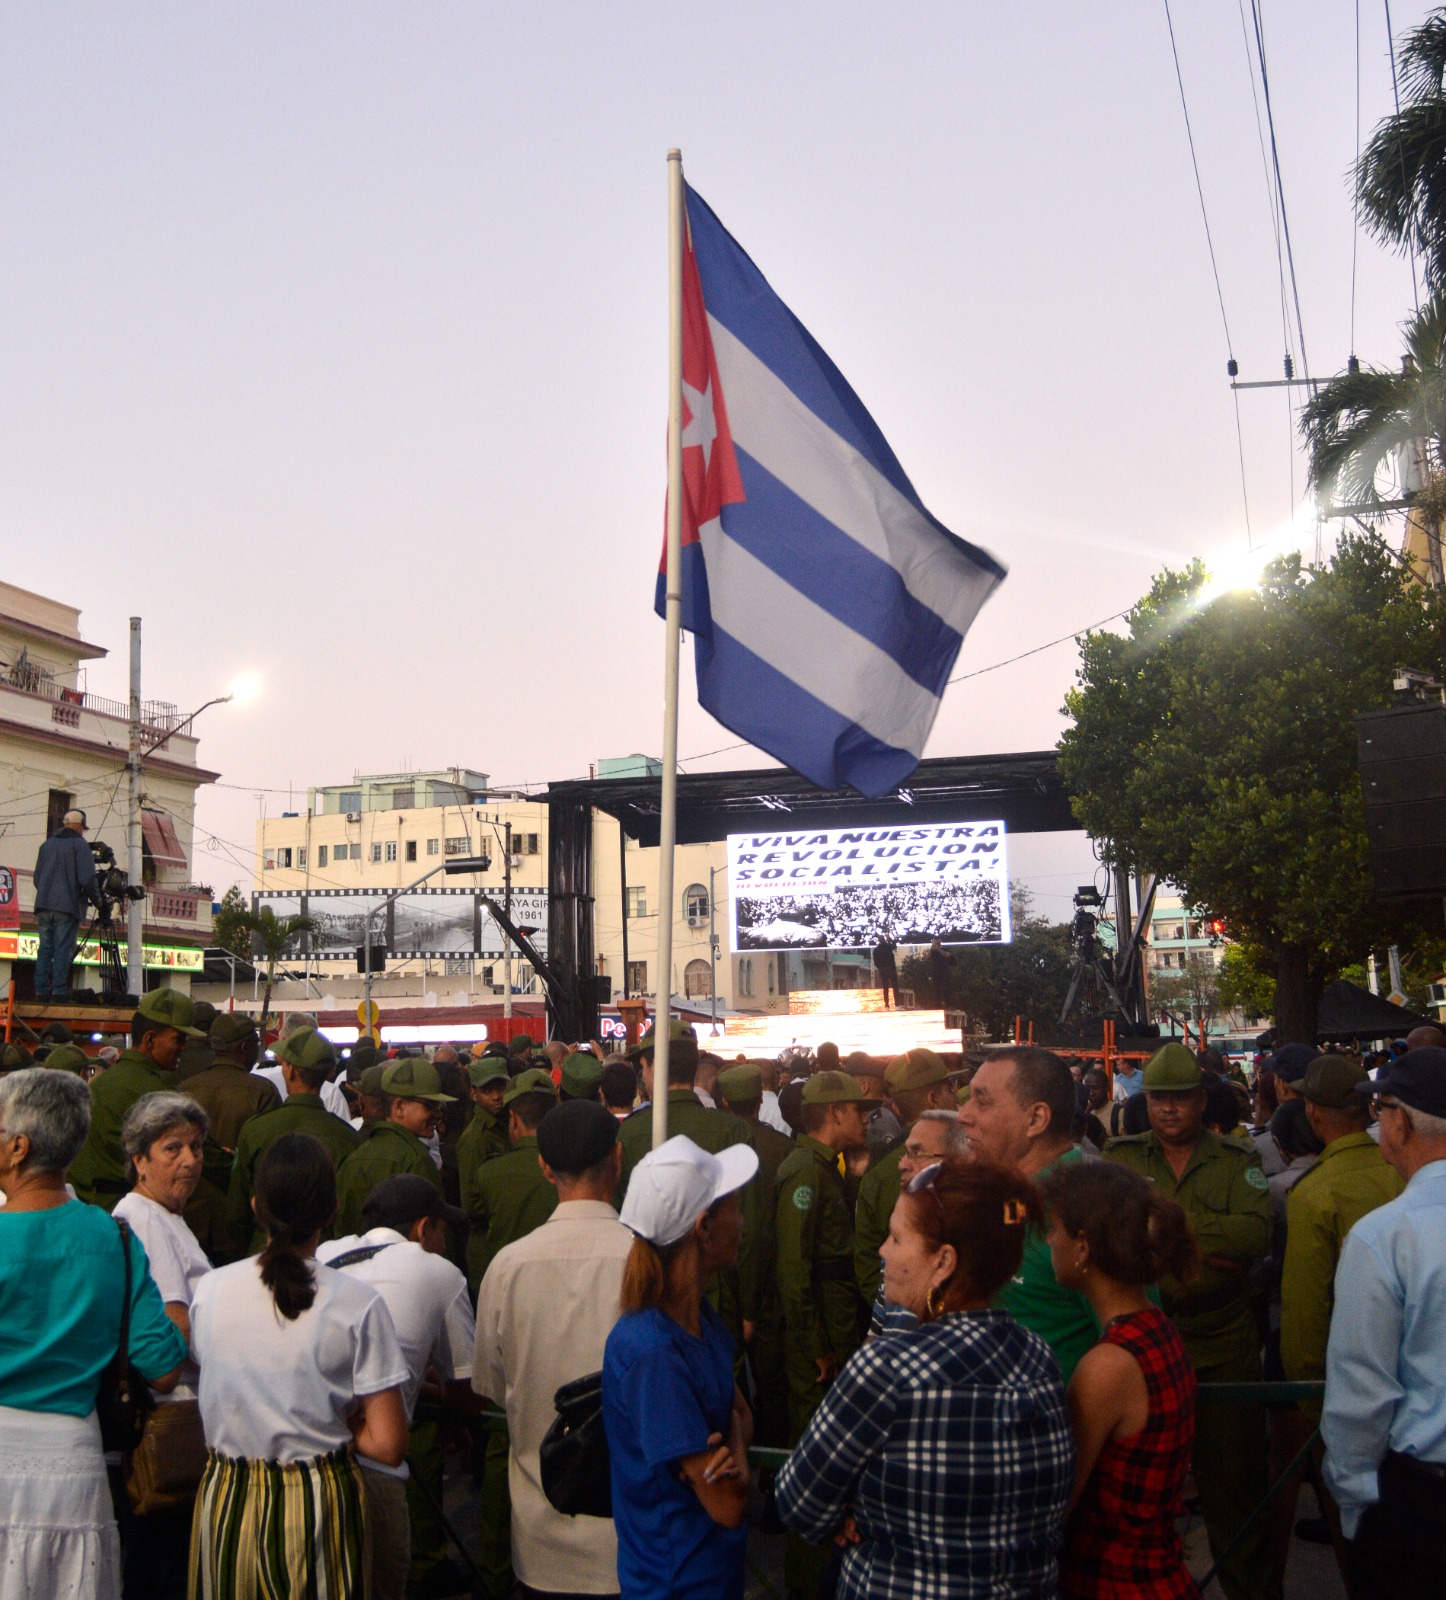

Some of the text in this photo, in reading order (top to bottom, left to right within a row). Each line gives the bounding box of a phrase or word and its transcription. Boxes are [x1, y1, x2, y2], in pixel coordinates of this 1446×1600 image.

[838, 826, 999, 844] NUESTRA
[737, 842, 1000, 865] REVOLUCION
[736, 858, 1000, 881] SOCIALISTA!
[519, 910, 543, 920] 1961
